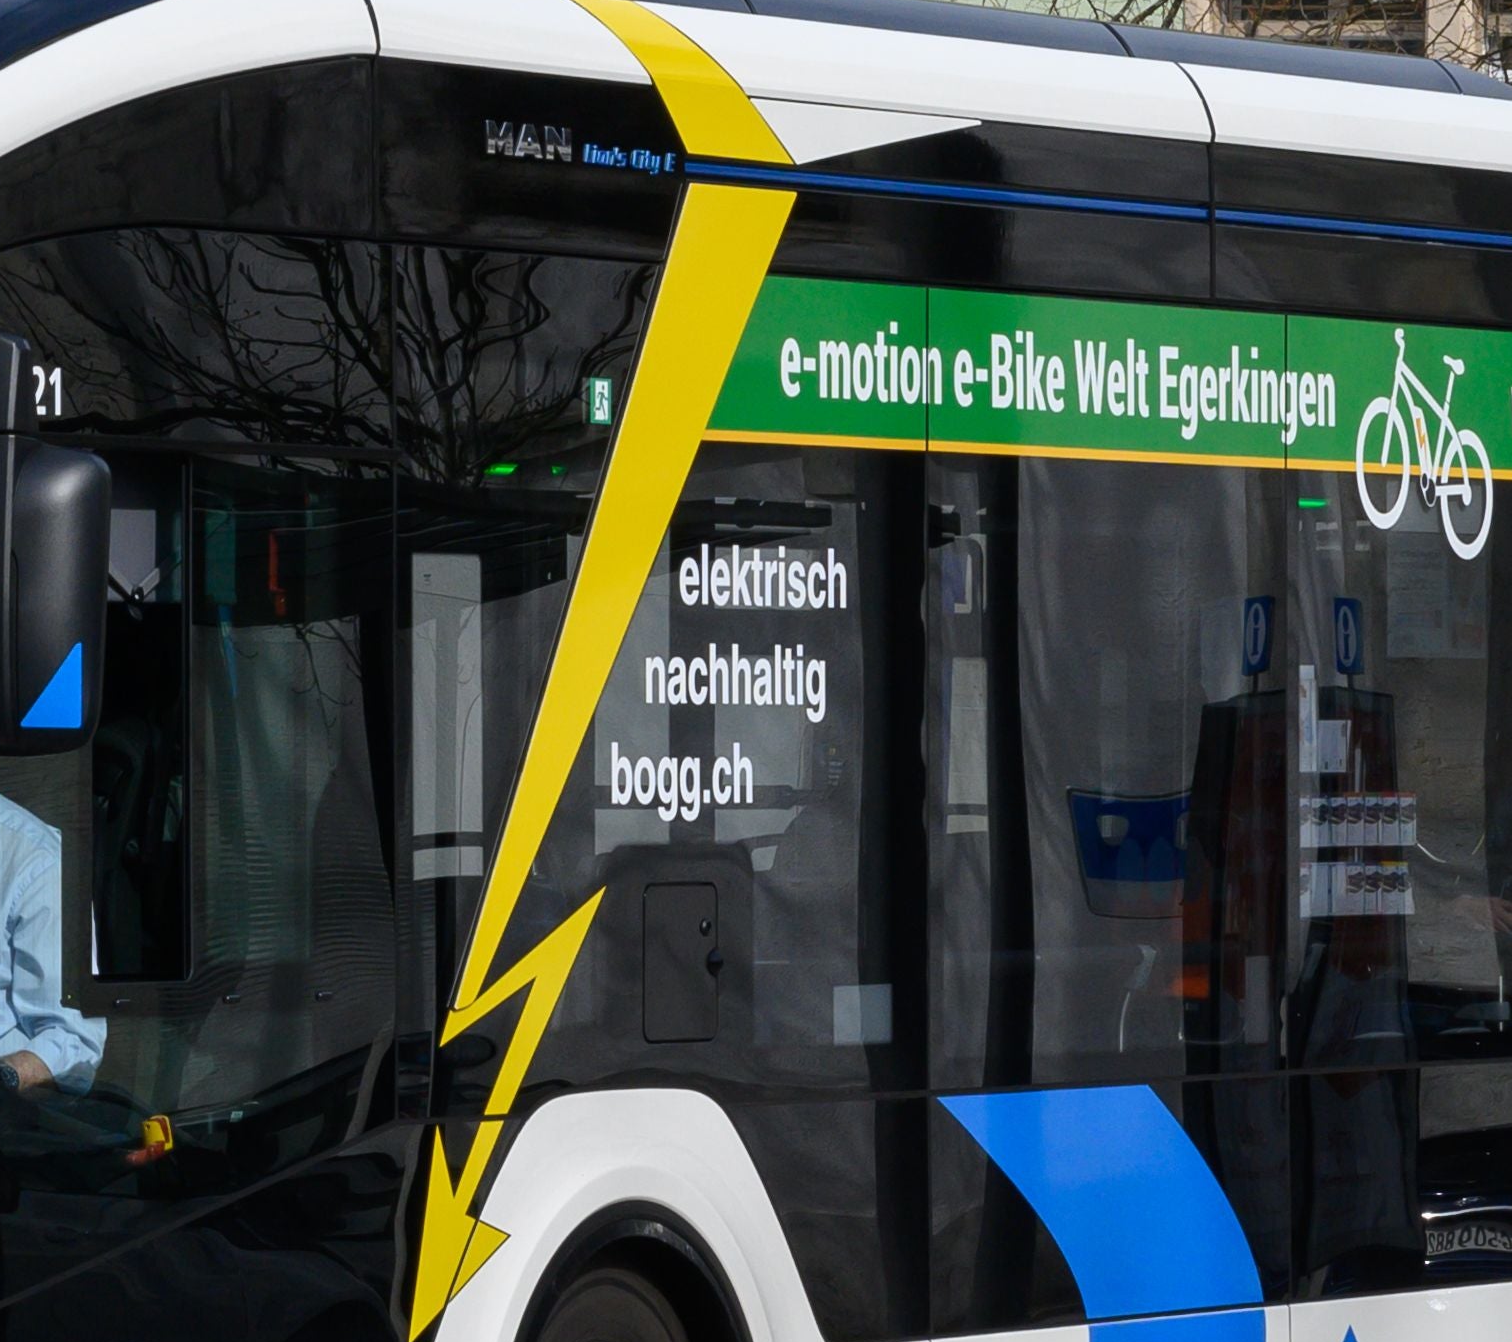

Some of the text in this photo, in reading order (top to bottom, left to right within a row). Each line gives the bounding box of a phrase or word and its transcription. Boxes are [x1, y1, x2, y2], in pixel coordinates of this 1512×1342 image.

[484, 119, 573, 163] MAN
[630, 148, 662, 176] City
[663, 151, 678, 174] E
[32, 365, 62, 417] 21
[780, 321, 1336, 446] e-motion e-Bike Welt Egerkingen
[678, 543, 847, 610] elektrisch
[645, 642, 826, 723] nachhaltig
[610, 741, 754, 822] bogg.ch
